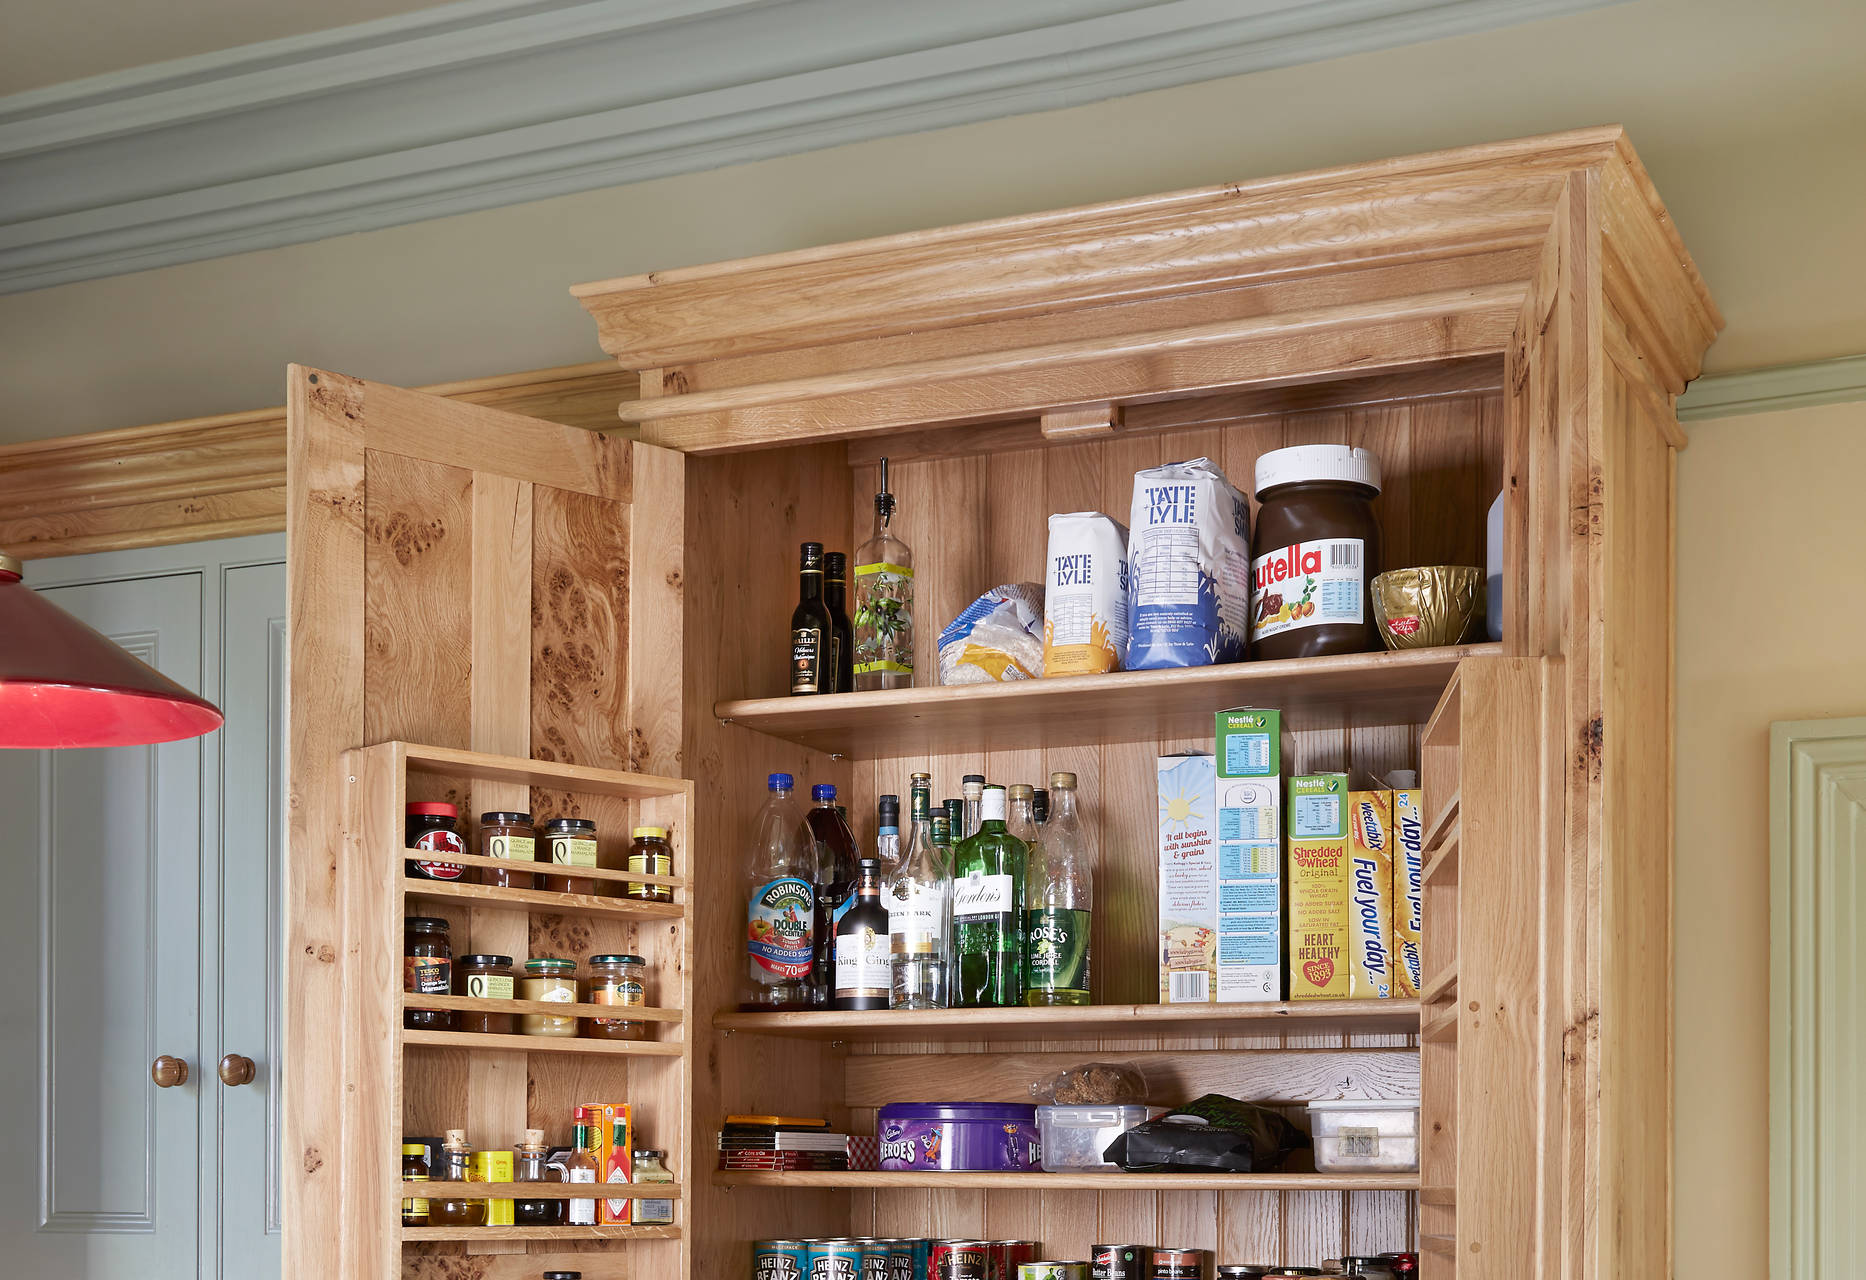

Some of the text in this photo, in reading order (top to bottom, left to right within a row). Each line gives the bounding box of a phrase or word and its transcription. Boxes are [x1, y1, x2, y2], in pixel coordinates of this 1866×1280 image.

[1144, 486, 1196, 506] TATE
[1148, 504, 1196, 525] LYLE
[1055, 554, 1092, 571] TATE
[1057, 569, 1092, 587] LYLE
[1227, 715, 1254, 724] Nestlé
[1295, 778, 1325, 788] Nestlé
[1398, 793, 1409, 808] 24
[1165, 829, 1208, 842] It all begins
[1164, 838, 1212, 852] with sunshine
[1181, 848, 1205, 860] grains
[1293, 845, 1343, 861] Shredded
[1299, 868, 1339, 879] Original
[1353, 857, 1379, 896] Fuel
[765, 883, 813, 908] ROBINSONS
[953, 884, 1001, 907] Gordon's
[1354, 894, 1381, 940] your
[773, 918, 807, 932] DOUBLE
[1304, 933, 1335, 947] HEART
[761, 945, 773, 954] NO
[773, 947, 798, 958] ADDED
[1298, 946, 1341, 960] HEALTHY
[784, 965, 798, 976] 70
[1306, 961, 1330, 974] SINCE
[1308, 969, 1332, 983] 1893
[619, 985, 643, 993] Bderim
[1378, 983, 1389, 999] 24
[879, 1139, 916, 1164] HEROES
[760, 1257, 792, 1269] HEINZ
[816, 1259, 850, 1273] HEINZ
[863, 1257, 886, 1271] EINZ
[890, 1256, 910, 1269] EINZ
[947, 1252, 983, 1266] HEINZ
[1106, 1267, 1126, 1278] Bans
